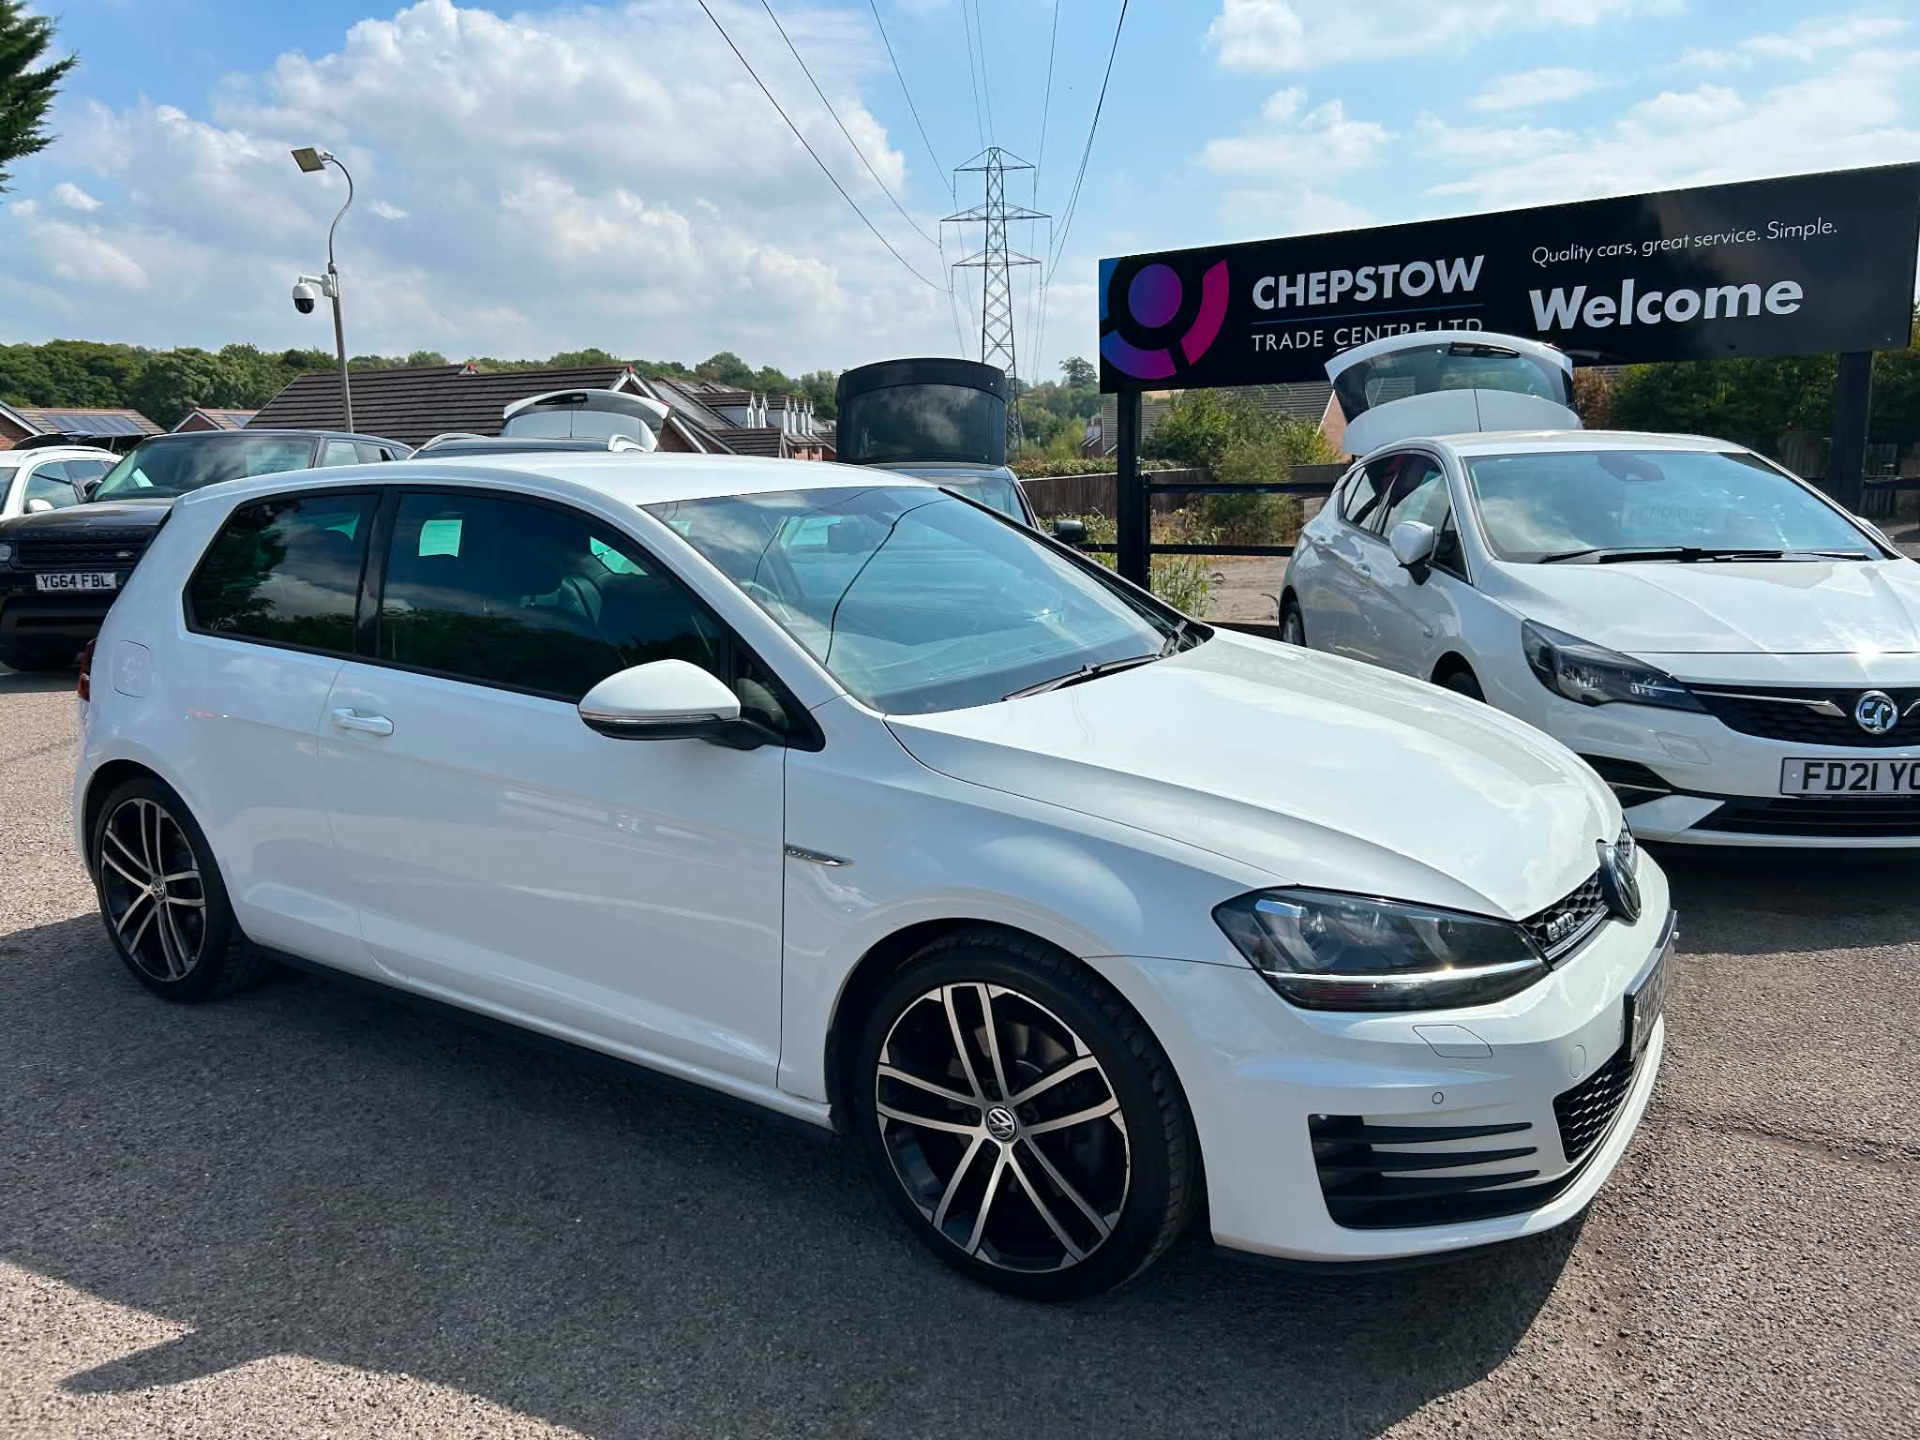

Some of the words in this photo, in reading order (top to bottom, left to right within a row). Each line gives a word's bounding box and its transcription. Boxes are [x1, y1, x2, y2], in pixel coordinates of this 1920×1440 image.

[1531, 243, 1594, 267] Quality
[1596, 240, 1638, 257] cars,
[1641, 233, 1690, 257] great
[1693, 227, 1761, 247] service.
[1766, 217, 1838, 240] Simple.
[1251, 254, 1486, 311] CHEPSTOW
[1528, 278, 1804, 332] Welcome
[1251, 330, 1325, 352] TRADE
[41, 575, 77, 589] YG64
[81, 573, 111, 588] FBL
[1802, 762, 1879, 791] FD21
